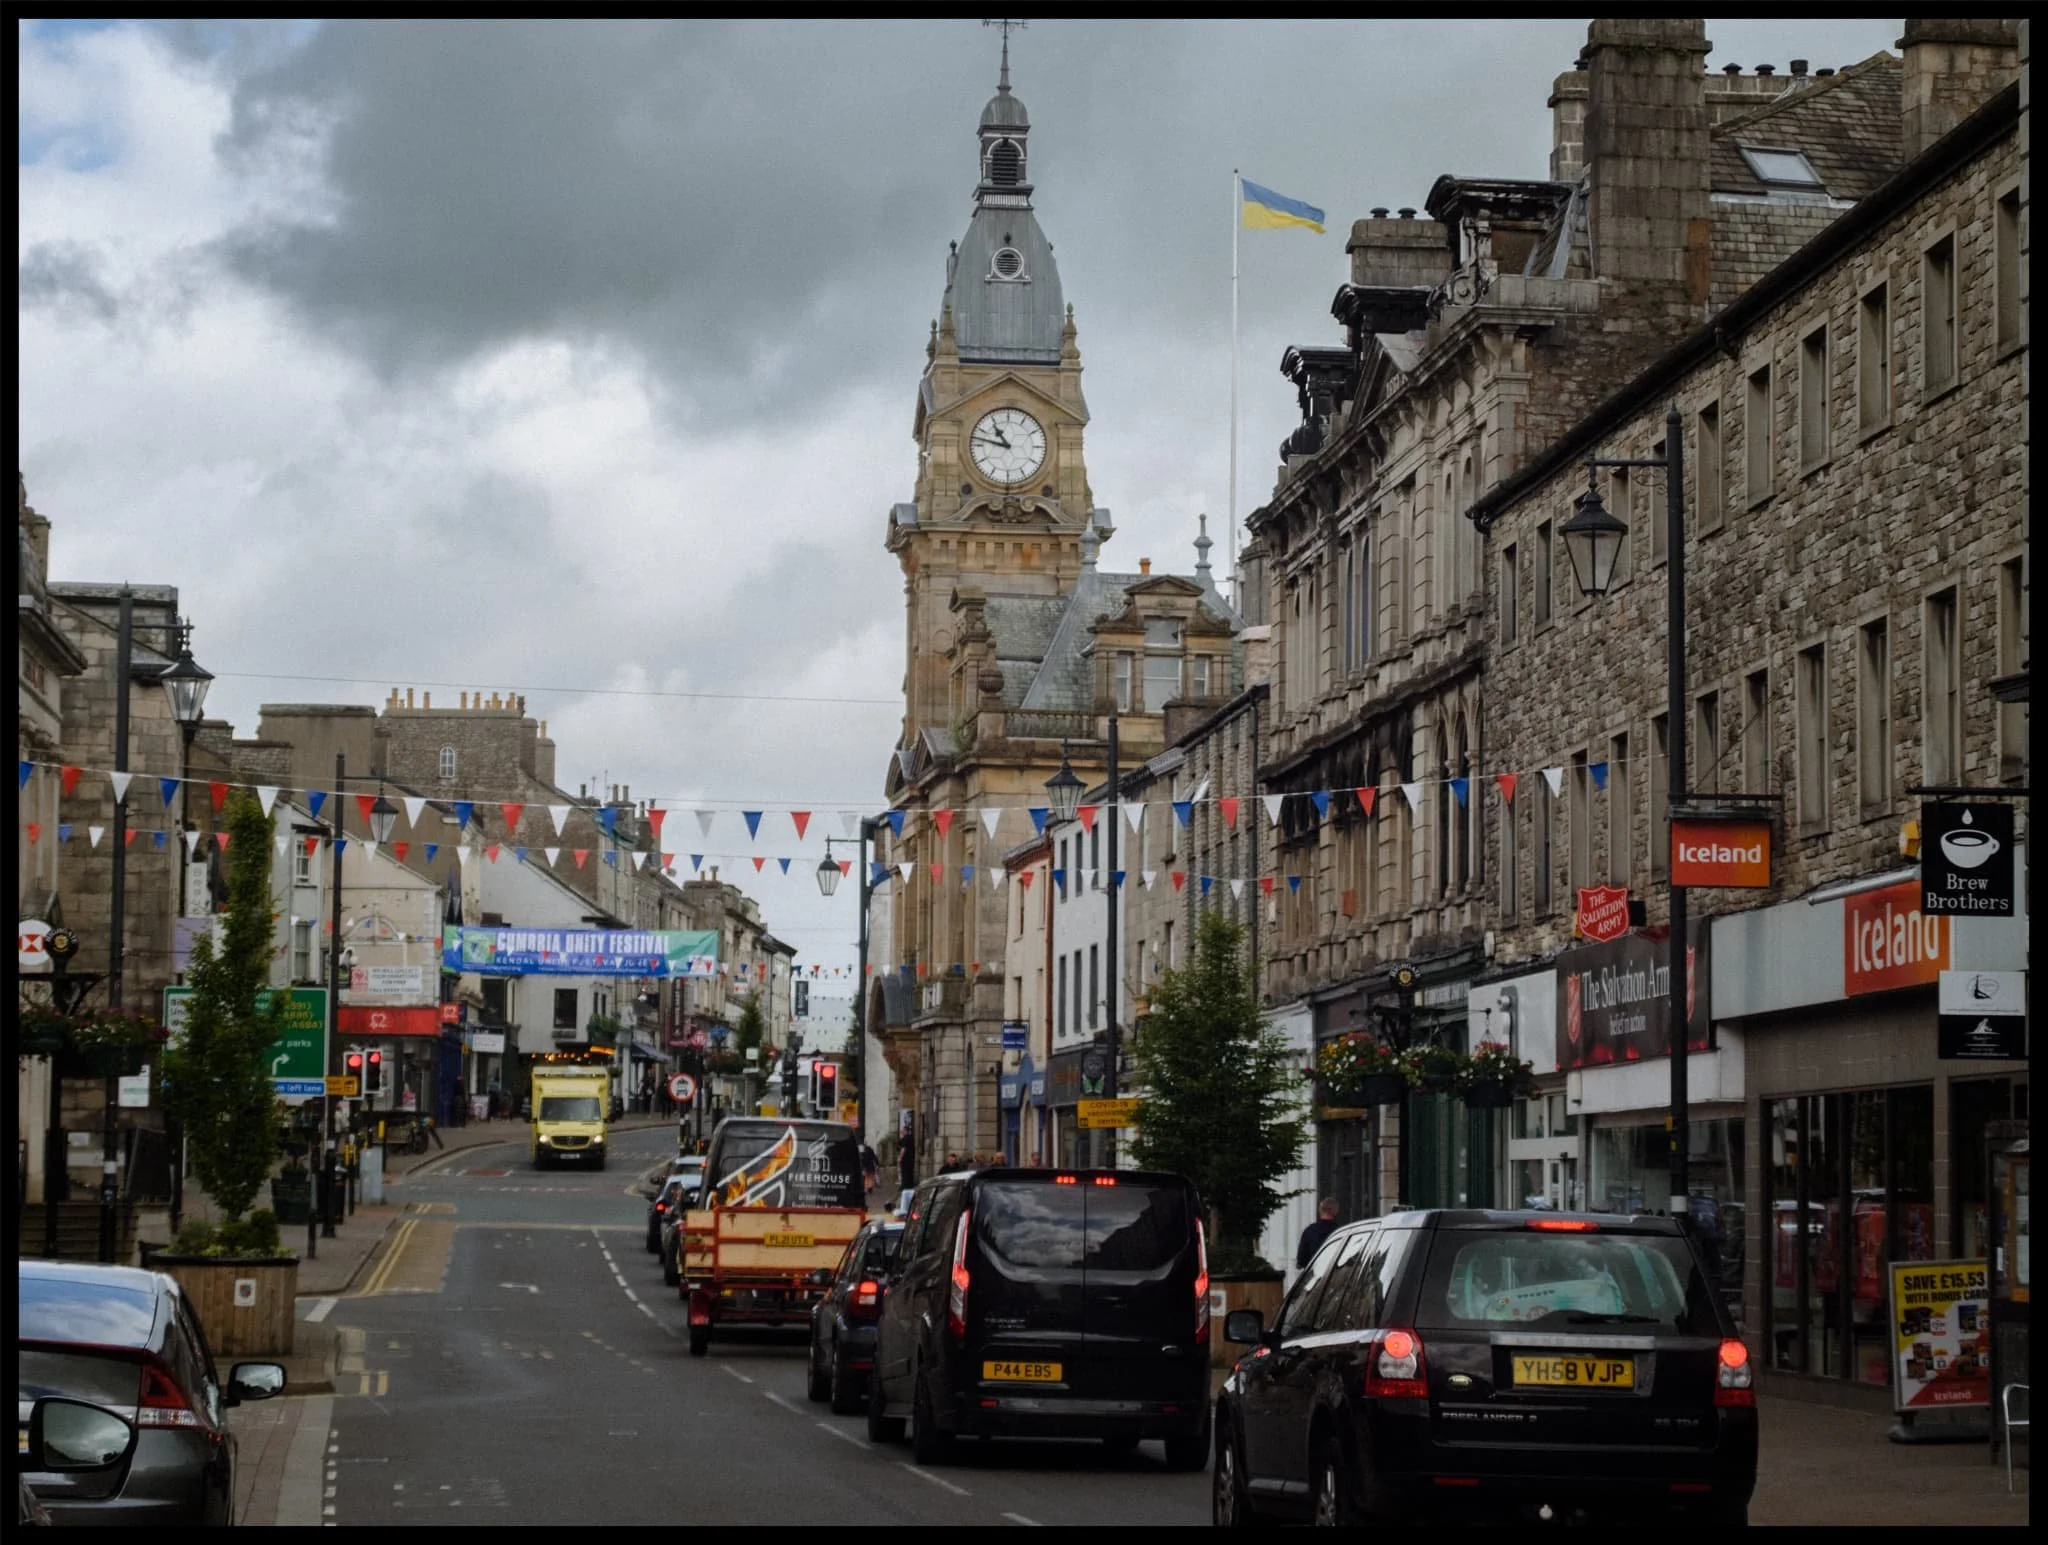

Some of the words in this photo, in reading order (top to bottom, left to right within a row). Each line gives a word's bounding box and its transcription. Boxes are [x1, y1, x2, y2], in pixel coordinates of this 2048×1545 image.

[1679, 843, 1762, 864] Iceland
[1946, 873, 1989, 890] Brew
[1589, 893, 1606, 908] THE
[1926, 892, 2009, 910] Brothers
[1582, 896, 1625, 927] SALVATION
[1597, 914, 1622, 934] ARMY
[496, 932, 560, 952] CUMBRIA
[565, 934, 604, 953] UNITY
[609, 935, 669, 954] FESTIVAL
[1853, 902, 1940, 973] Iceland
[1582, 970, 1600, 1011] The
[1601, 960, 1646, 1008] Salvation
[1647, 956, 1672, 1005] Arm
[286, 1040, 312, 1049] parks
[303, 1082, 322, 1091] lane
[1090, 1101, 1129, 1109] COVID-19
[788, 1172, 850, 1184] FIREHOUSE
[1903, 1274, 1937, 1291] SAVE
[1941, 1271, 1985, 1289] £15.53
[1905, 1293, 1929, 1305] WITH
[1932, 1290, 1961, 1303] BONUS
[1964, 1288, 1989, 1301] CARD
[993, 1363, 1020, 1377] P44
[1024, 1364, 1053, 1379] EBS
[1523, 1361, 1578, 1382] YH58
[1585, 1362, 1626, 1384] VJP
[1933, 1389, 1972, 1401] Iceland
[1441, 1411, 1524, 1423] FREELANDER
